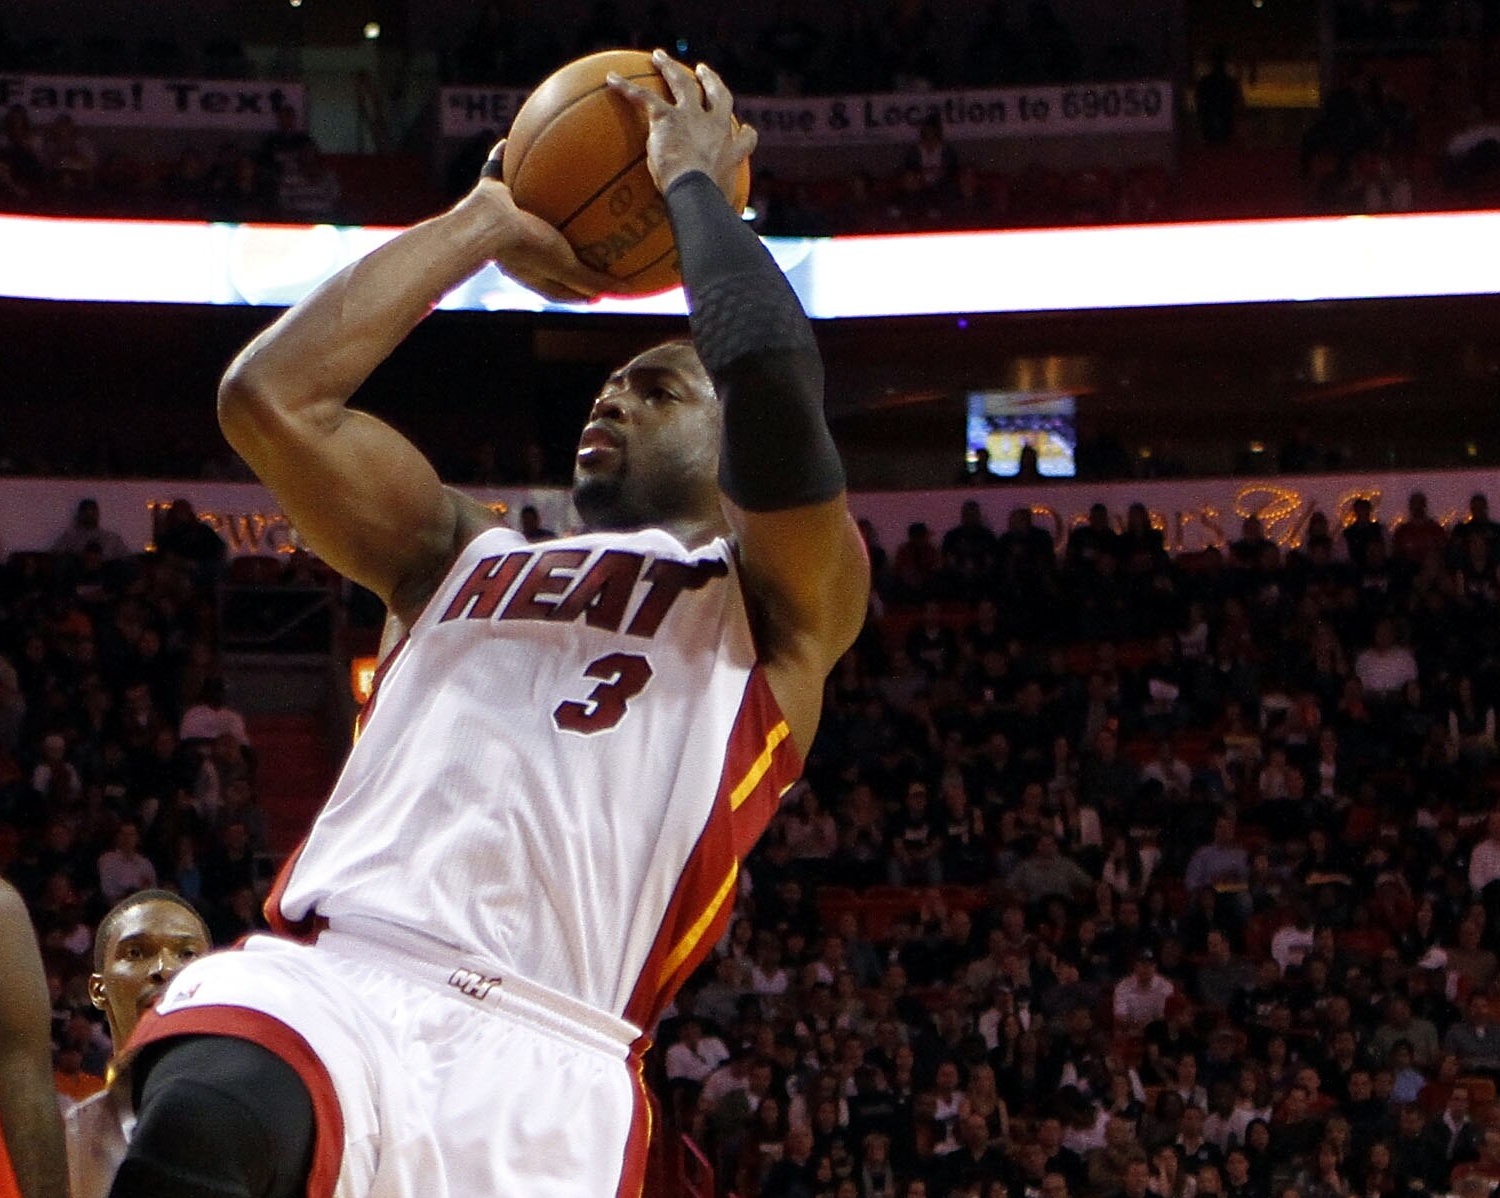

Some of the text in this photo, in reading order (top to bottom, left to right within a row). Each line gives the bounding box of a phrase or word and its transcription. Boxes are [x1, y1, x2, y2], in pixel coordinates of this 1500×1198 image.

[164, 83, 288, 114] Text
[864, 97, 1007, 130] Location
[1019, 96, 1049, 121] to
[438, 548, 728, 639] HEAT
[552, 651, 654, 737] 3
